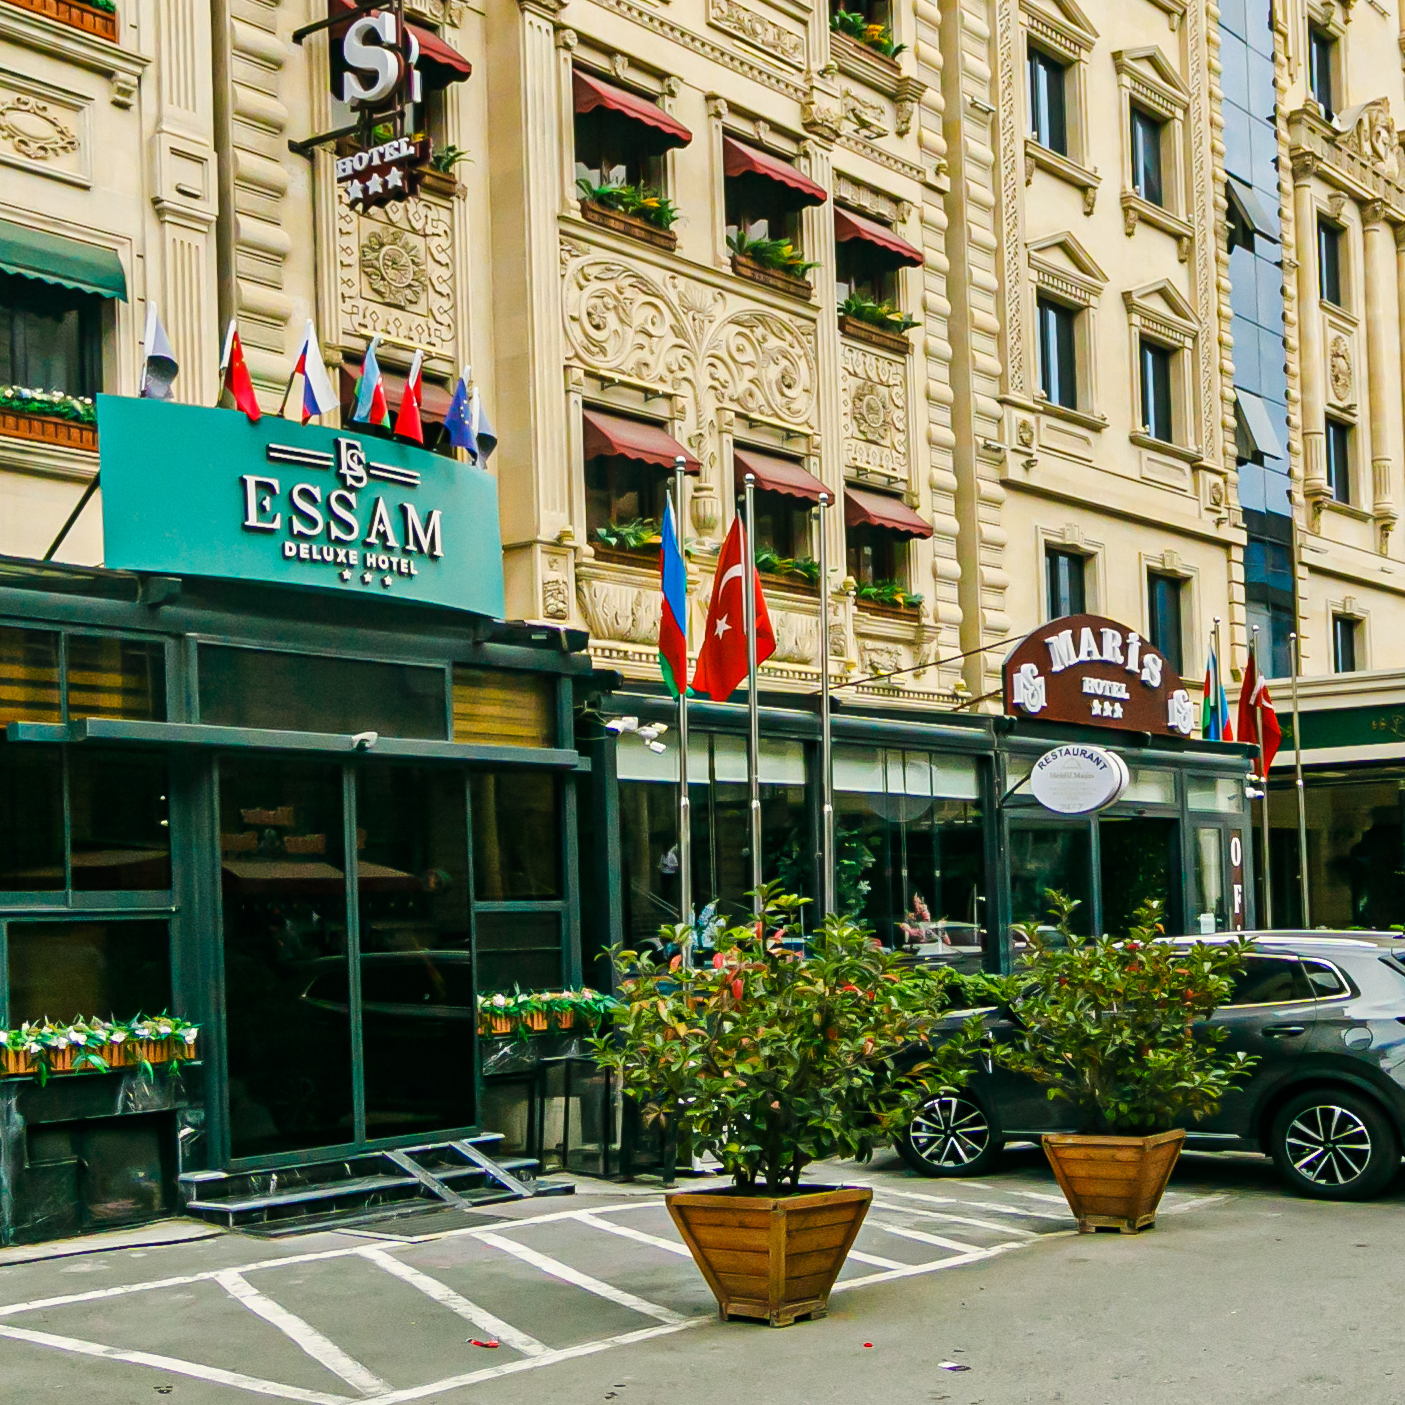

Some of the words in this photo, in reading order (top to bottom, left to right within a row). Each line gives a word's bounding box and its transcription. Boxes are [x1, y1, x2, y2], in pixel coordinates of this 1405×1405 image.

[336, 137, 415, 178] HOTEL
[241, 474, 445, 558] ESSAM
[283, 541, 359, 566] DELUXE
[366, 552, 419, 576] HOTEL
[1082, 676, 1130, 700] HOTEL
[1037, 747, 1108, 771] RESTAURANT
[1230, 837, 1242, 931] OF
